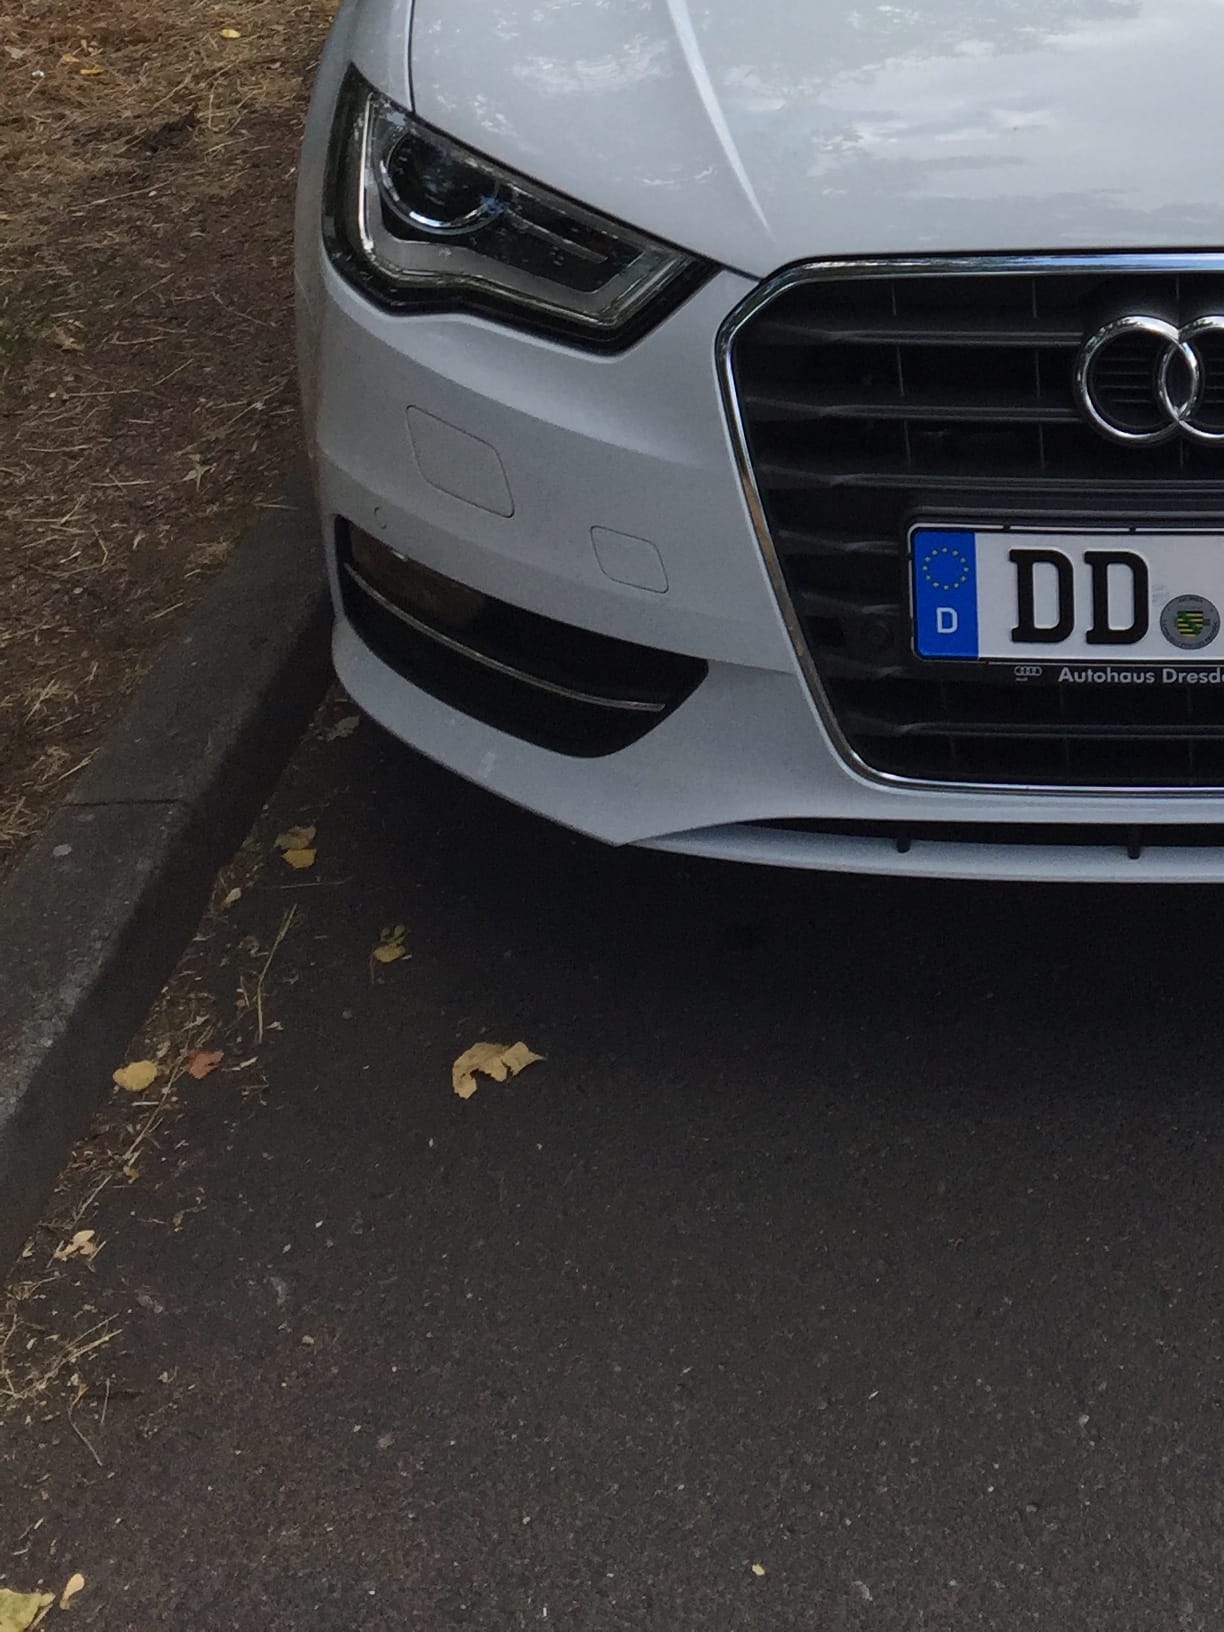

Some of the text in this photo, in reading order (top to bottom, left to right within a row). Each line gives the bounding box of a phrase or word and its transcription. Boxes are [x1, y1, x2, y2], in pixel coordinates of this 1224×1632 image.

[1008, 548, 1150, 645] DD
[936, 607, 958, 634] D
[1057, 666, 1155, 684] Autohaus
